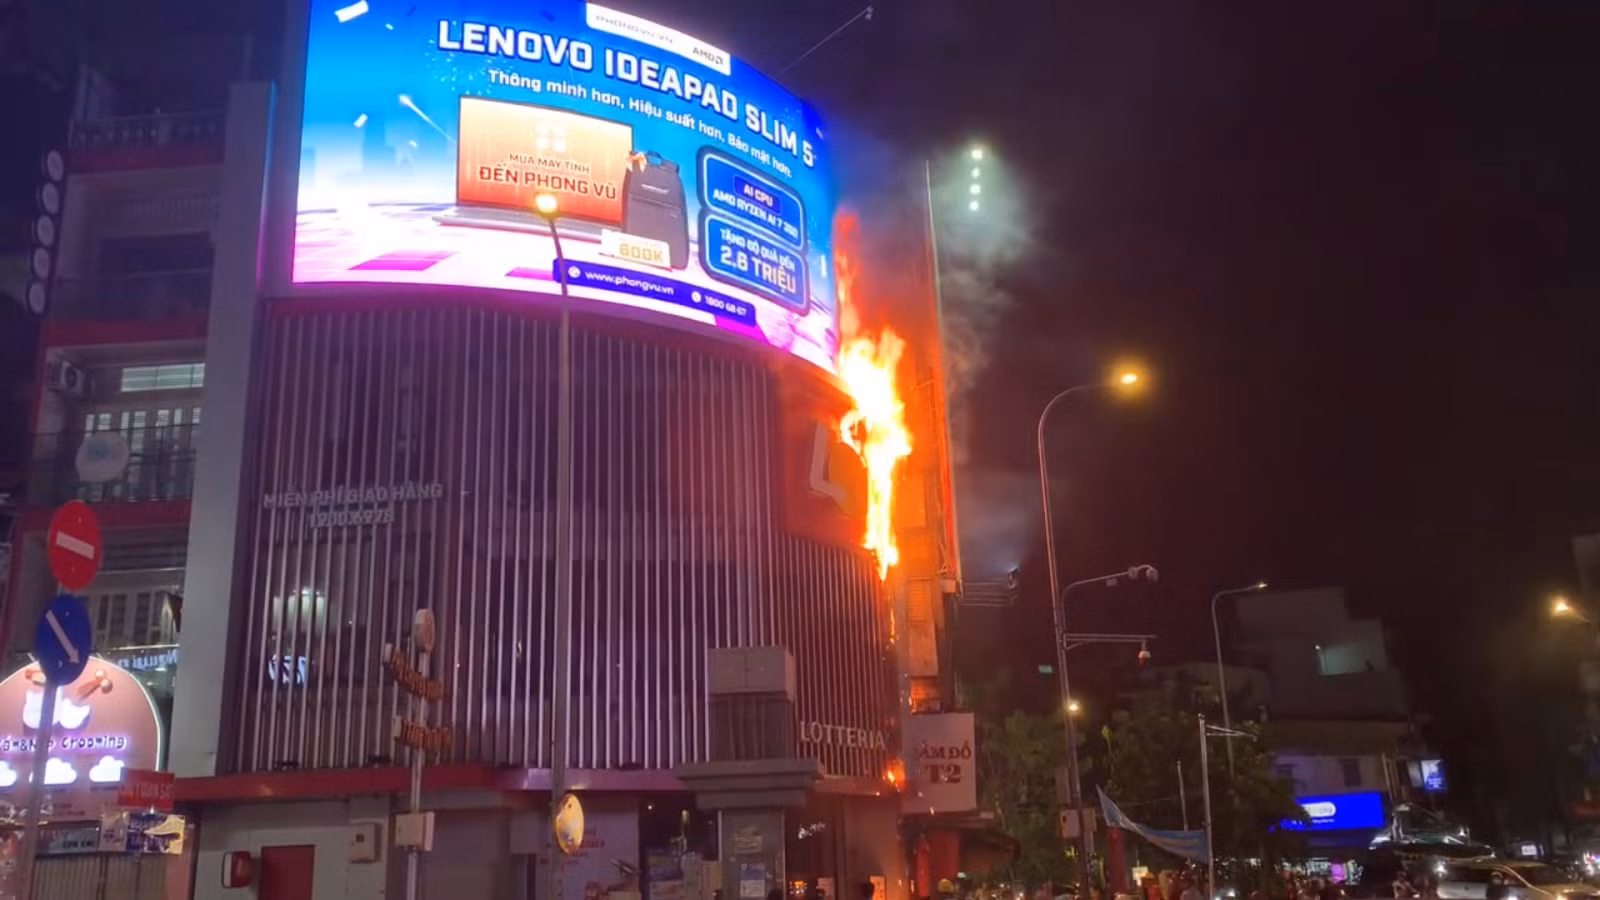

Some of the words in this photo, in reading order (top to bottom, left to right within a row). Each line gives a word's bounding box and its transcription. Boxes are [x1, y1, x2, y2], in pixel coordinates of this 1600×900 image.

[692, 46, 716, 63] AMD
[438, 20, 593, 71] LENOVO
[605, 48, 738, 120] IDEAPAD
[745, 103, 797, 156] SLIM
[802, 140, 815, 167] 5
[487, 69, 542, 93] Thông
[546, 80, 588, 99] minh
[591, 87, 625, 110] hơn,
[629, 97, 663, 119] Hiệu
[665, 109, 696, 131] suất
[698, 120, 726, 144] hơn,
[727, 132, 750, 153] Bảo
[750, 147, 772, 167] mật
[509, 152, 536, 165] MUA
[479, 162, 519, 184] ĐẾN
[524, 171, 589, 195] PHONG
[593, 181, 617, 200] VŨ
[713, 188, 736, 207] AMD
[737, 198, 767, 220] RYZEN
[743, 184, 754, 199] AI
[755, 190, 774, 208] CPU
[719, 228, 746, 248] TẶNG
[619, 242, 665, 265] 600K
[584, 271, 675, 296] www.phongvu.vn
[751, 256, 797, 294] TRIỆU
[392, 480, 443, 501] HÀNG
[61, 734, 128, 751] Grooming
[801, 720, 886, 750] LOTTERIA
[925, 763, 961, 785] T2
